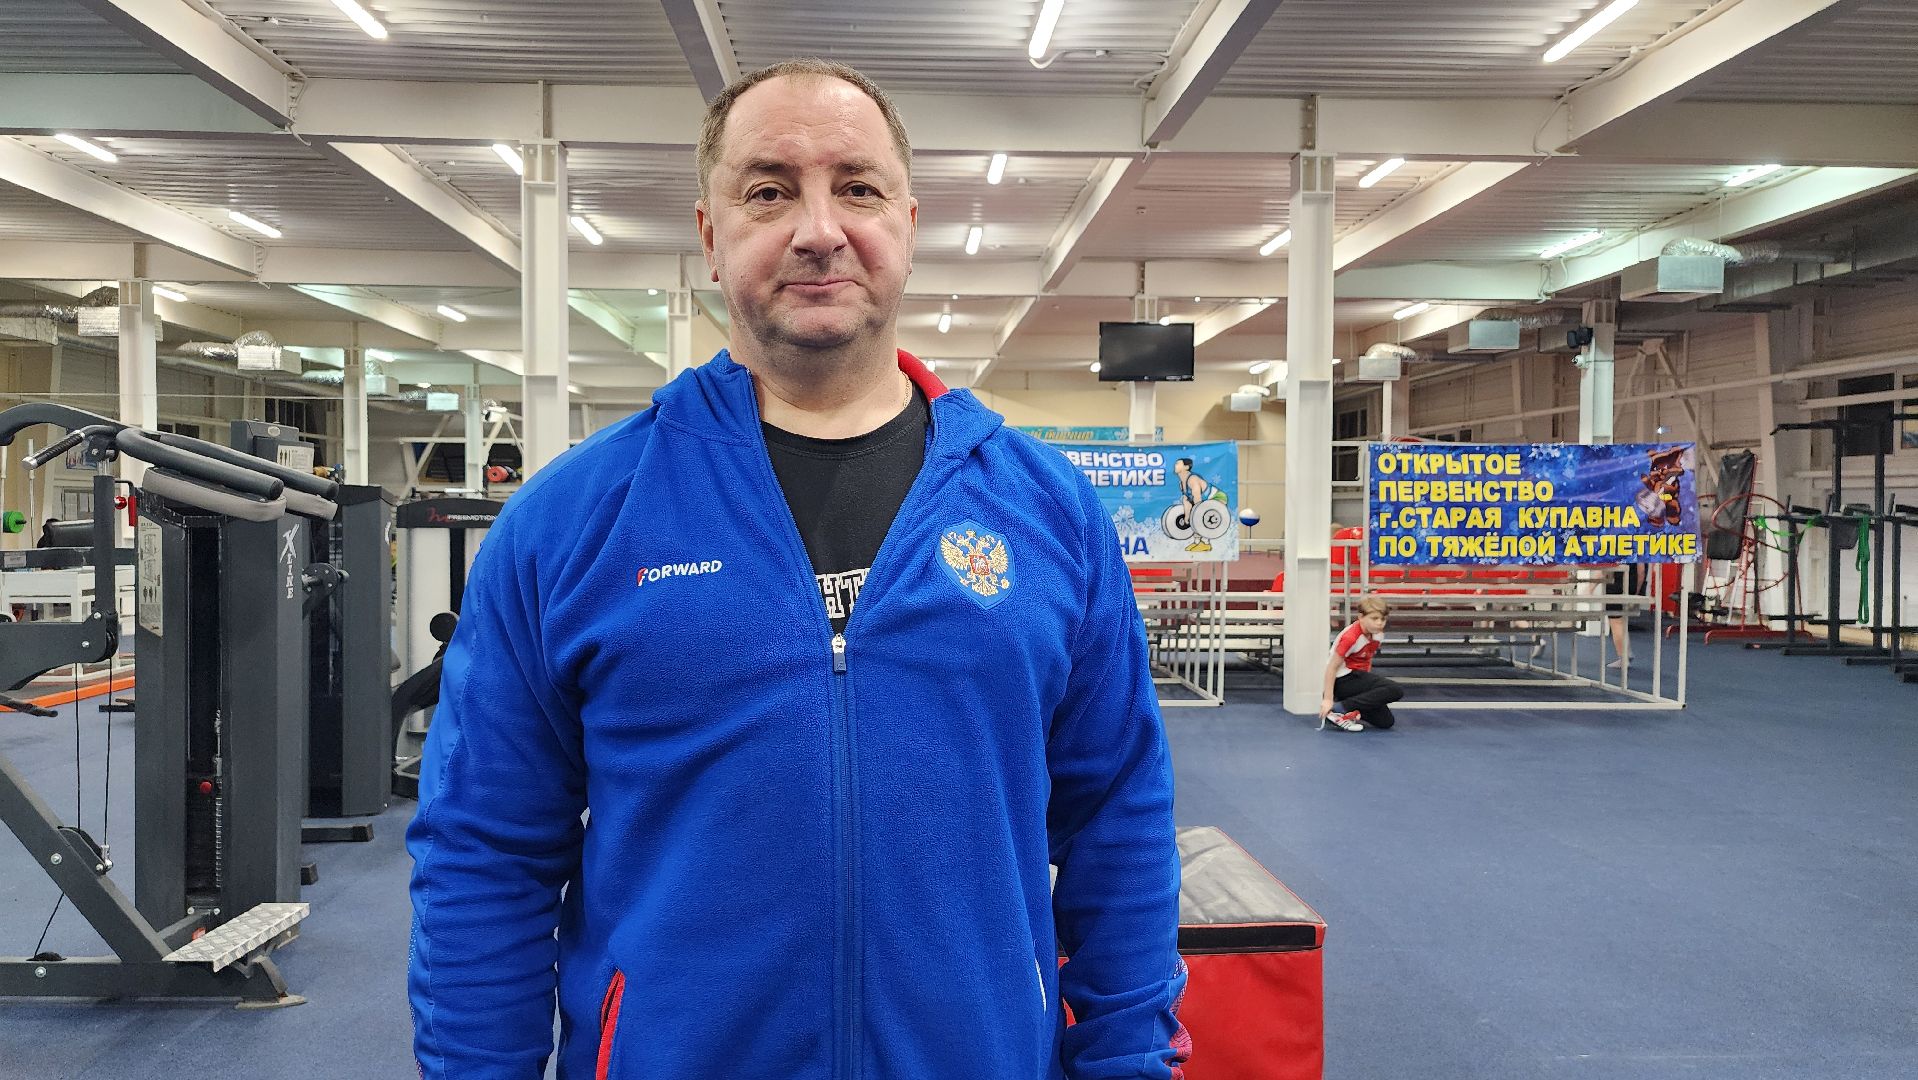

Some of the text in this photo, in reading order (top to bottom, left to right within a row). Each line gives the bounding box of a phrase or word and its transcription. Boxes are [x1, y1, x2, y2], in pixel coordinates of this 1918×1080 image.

[1377, 452, 1521, 475] ОТКРЫТОЕ
[1083, 469, 1165, 486] ЛЕТИКЕ
[1378, 480, 1554, 502] ПЕРВЕНСТВО
[1379, 506, 1641, 529] г.СТАРАЯ КУПАВНА
[1120, 536, 1150, 555] НА
[1379, 531, 1697, 557] ПО ТЯЖЁЛОЙ АТЛЕТИКЕ
[637, 560, 723, 587] FORWARD
